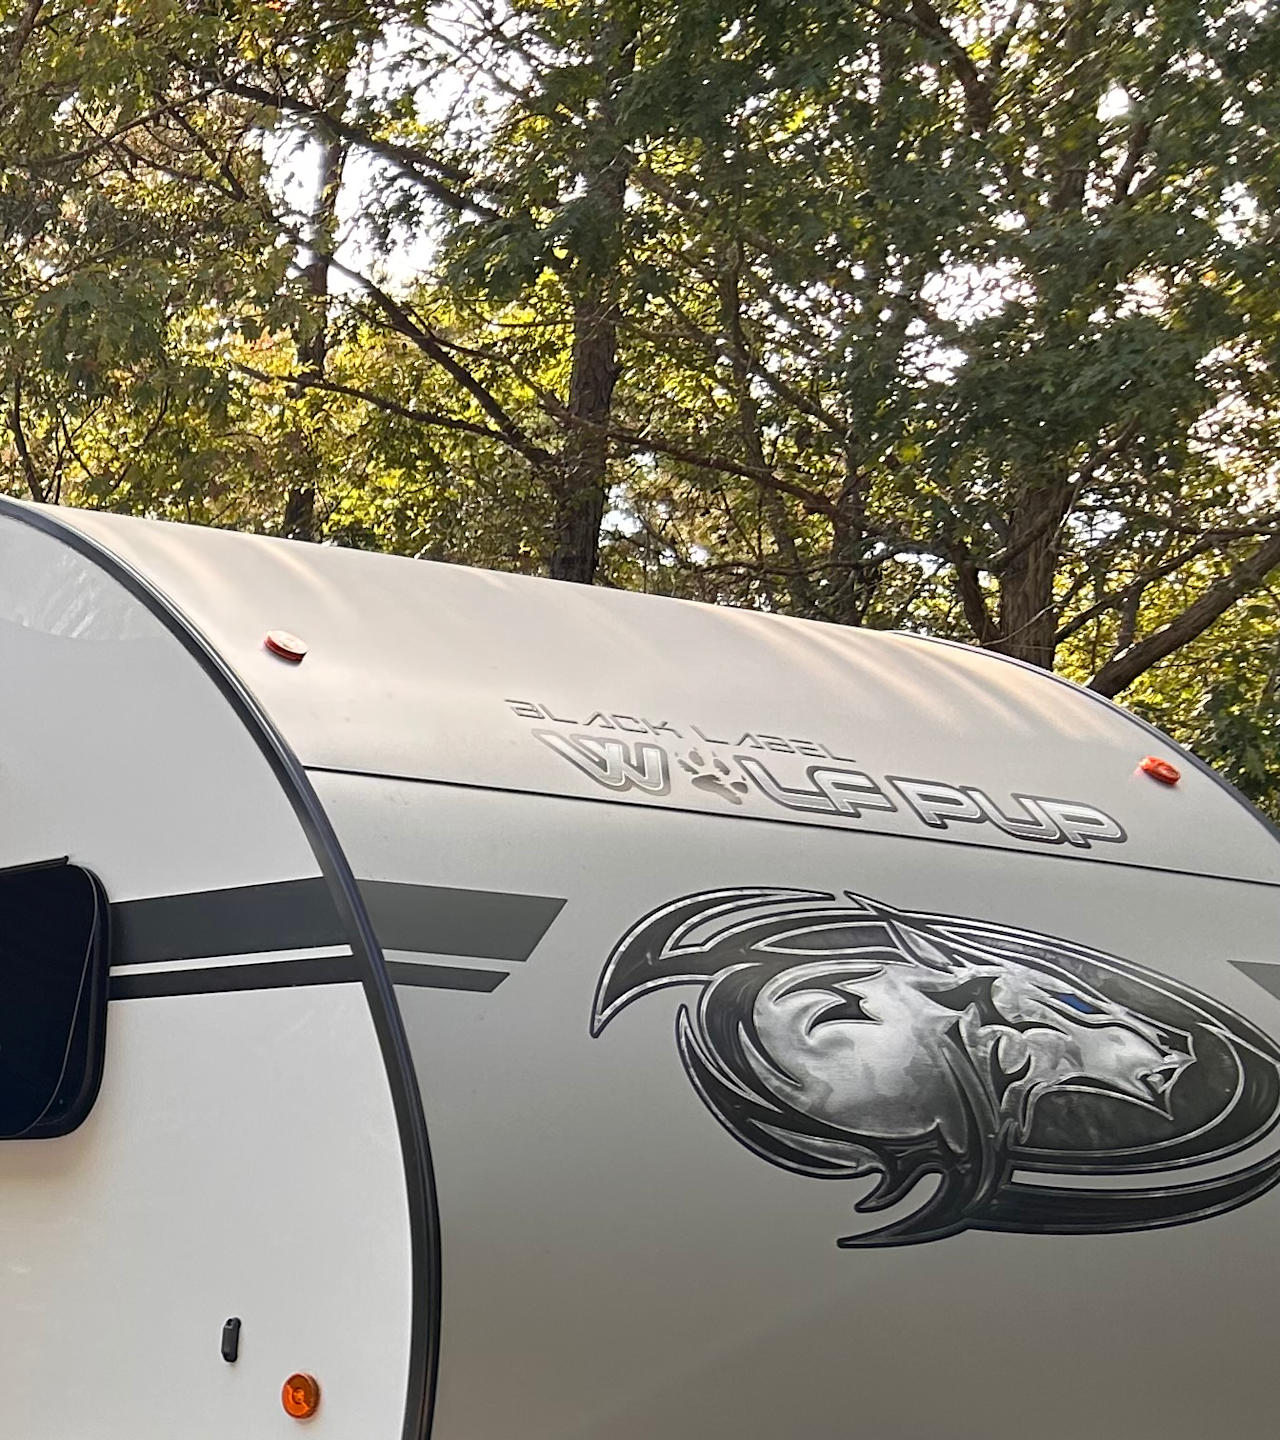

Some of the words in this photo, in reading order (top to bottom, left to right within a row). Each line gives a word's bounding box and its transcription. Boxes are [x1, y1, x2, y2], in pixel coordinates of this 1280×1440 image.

[505, 699, 683, 739] BLACK
[690, 725, 856, 763] LABEL
[884, 775, 1128, 849] PUP
